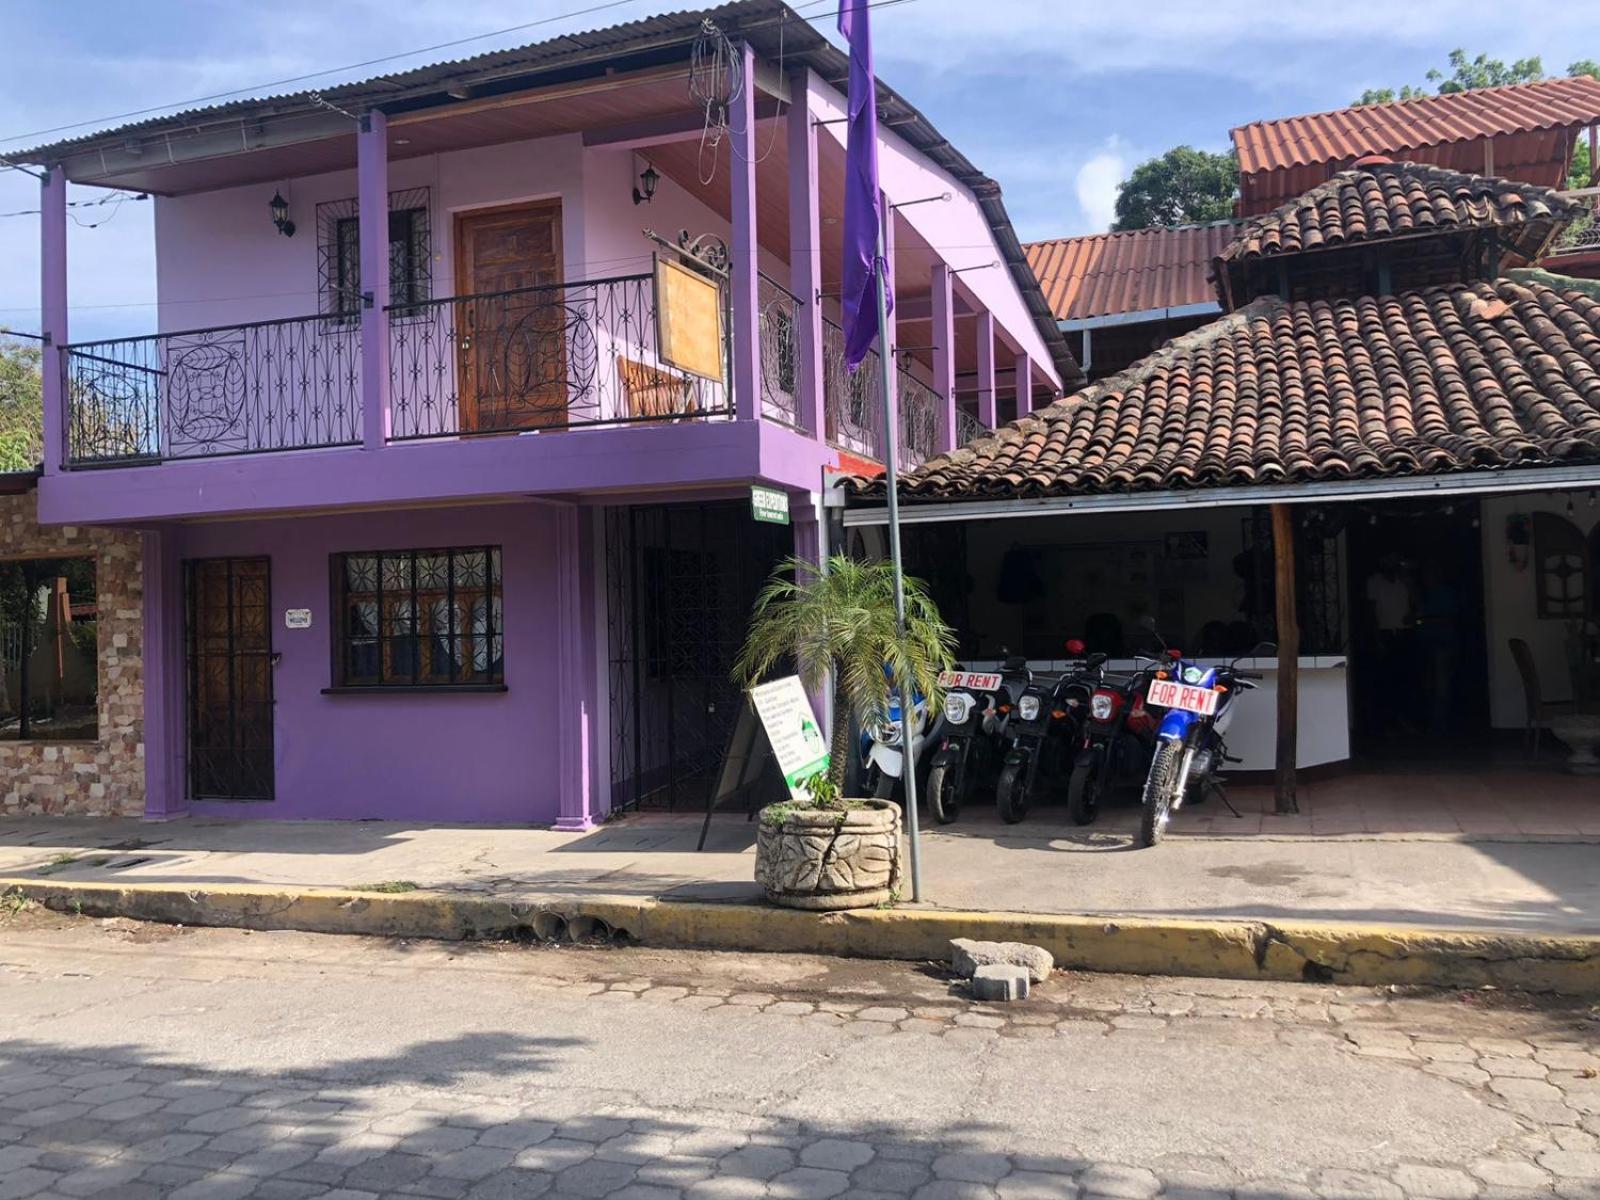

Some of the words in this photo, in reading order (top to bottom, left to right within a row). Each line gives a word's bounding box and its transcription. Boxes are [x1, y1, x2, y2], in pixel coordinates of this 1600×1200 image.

[939, 672, 963, 687] FOR
[966, 674, 1000, 689] RENT
[1150, 682, 1177, 705] FOR
[1180, 687, 1214, 713] RENT
